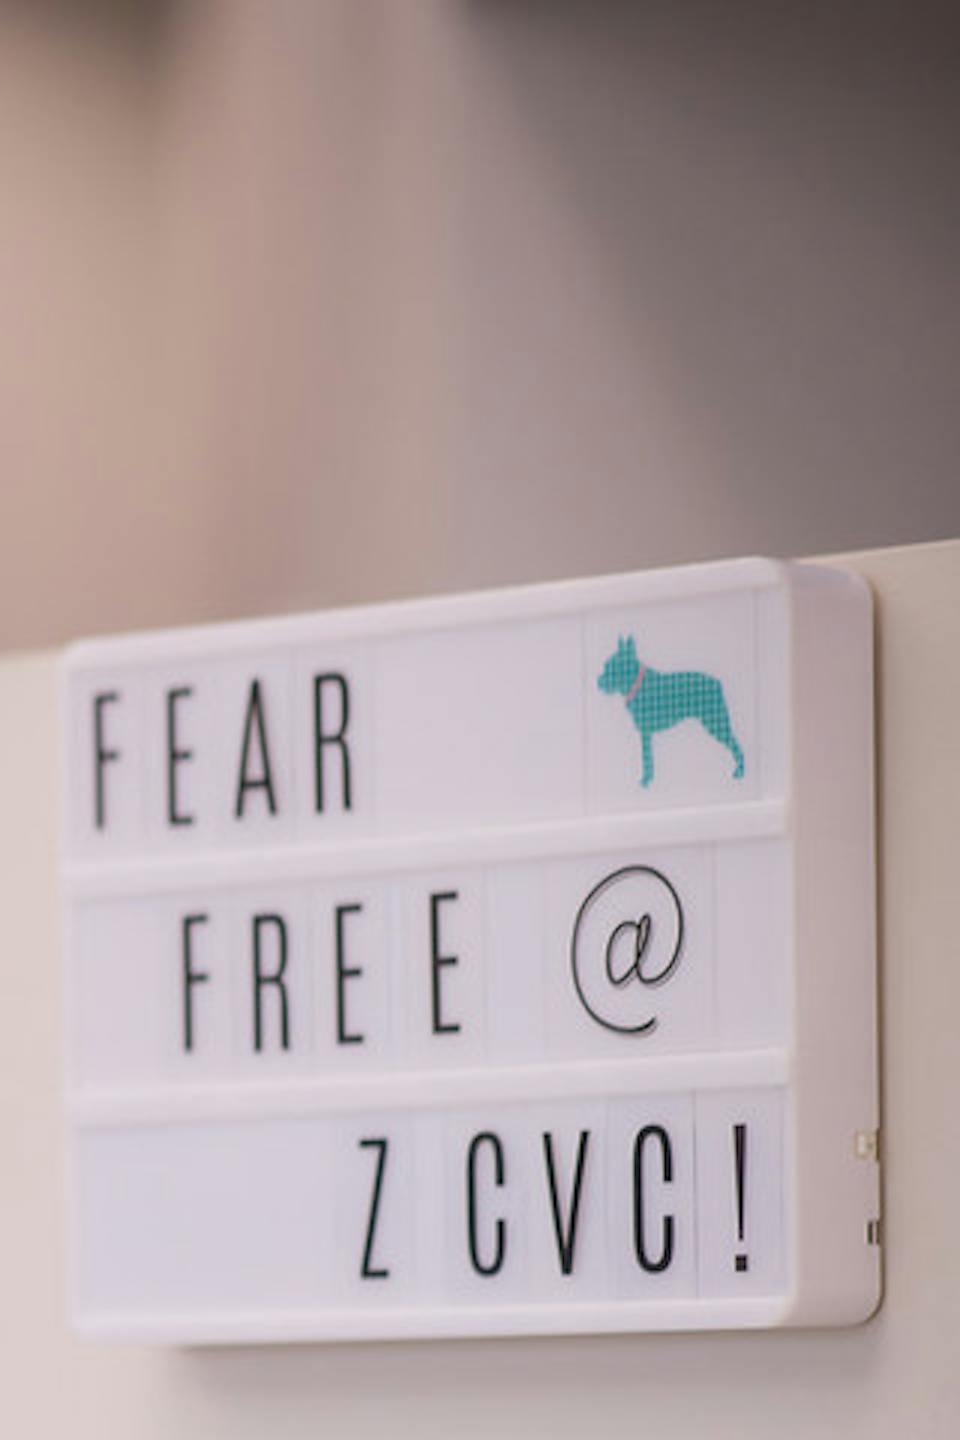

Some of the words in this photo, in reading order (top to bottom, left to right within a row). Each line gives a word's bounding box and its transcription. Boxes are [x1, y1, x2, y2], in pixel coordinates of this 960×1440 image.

[93, 671, 354, 831] FEAR
[181, 890, 461, 1054] FREE
[570, 864, 684, 1034] @
